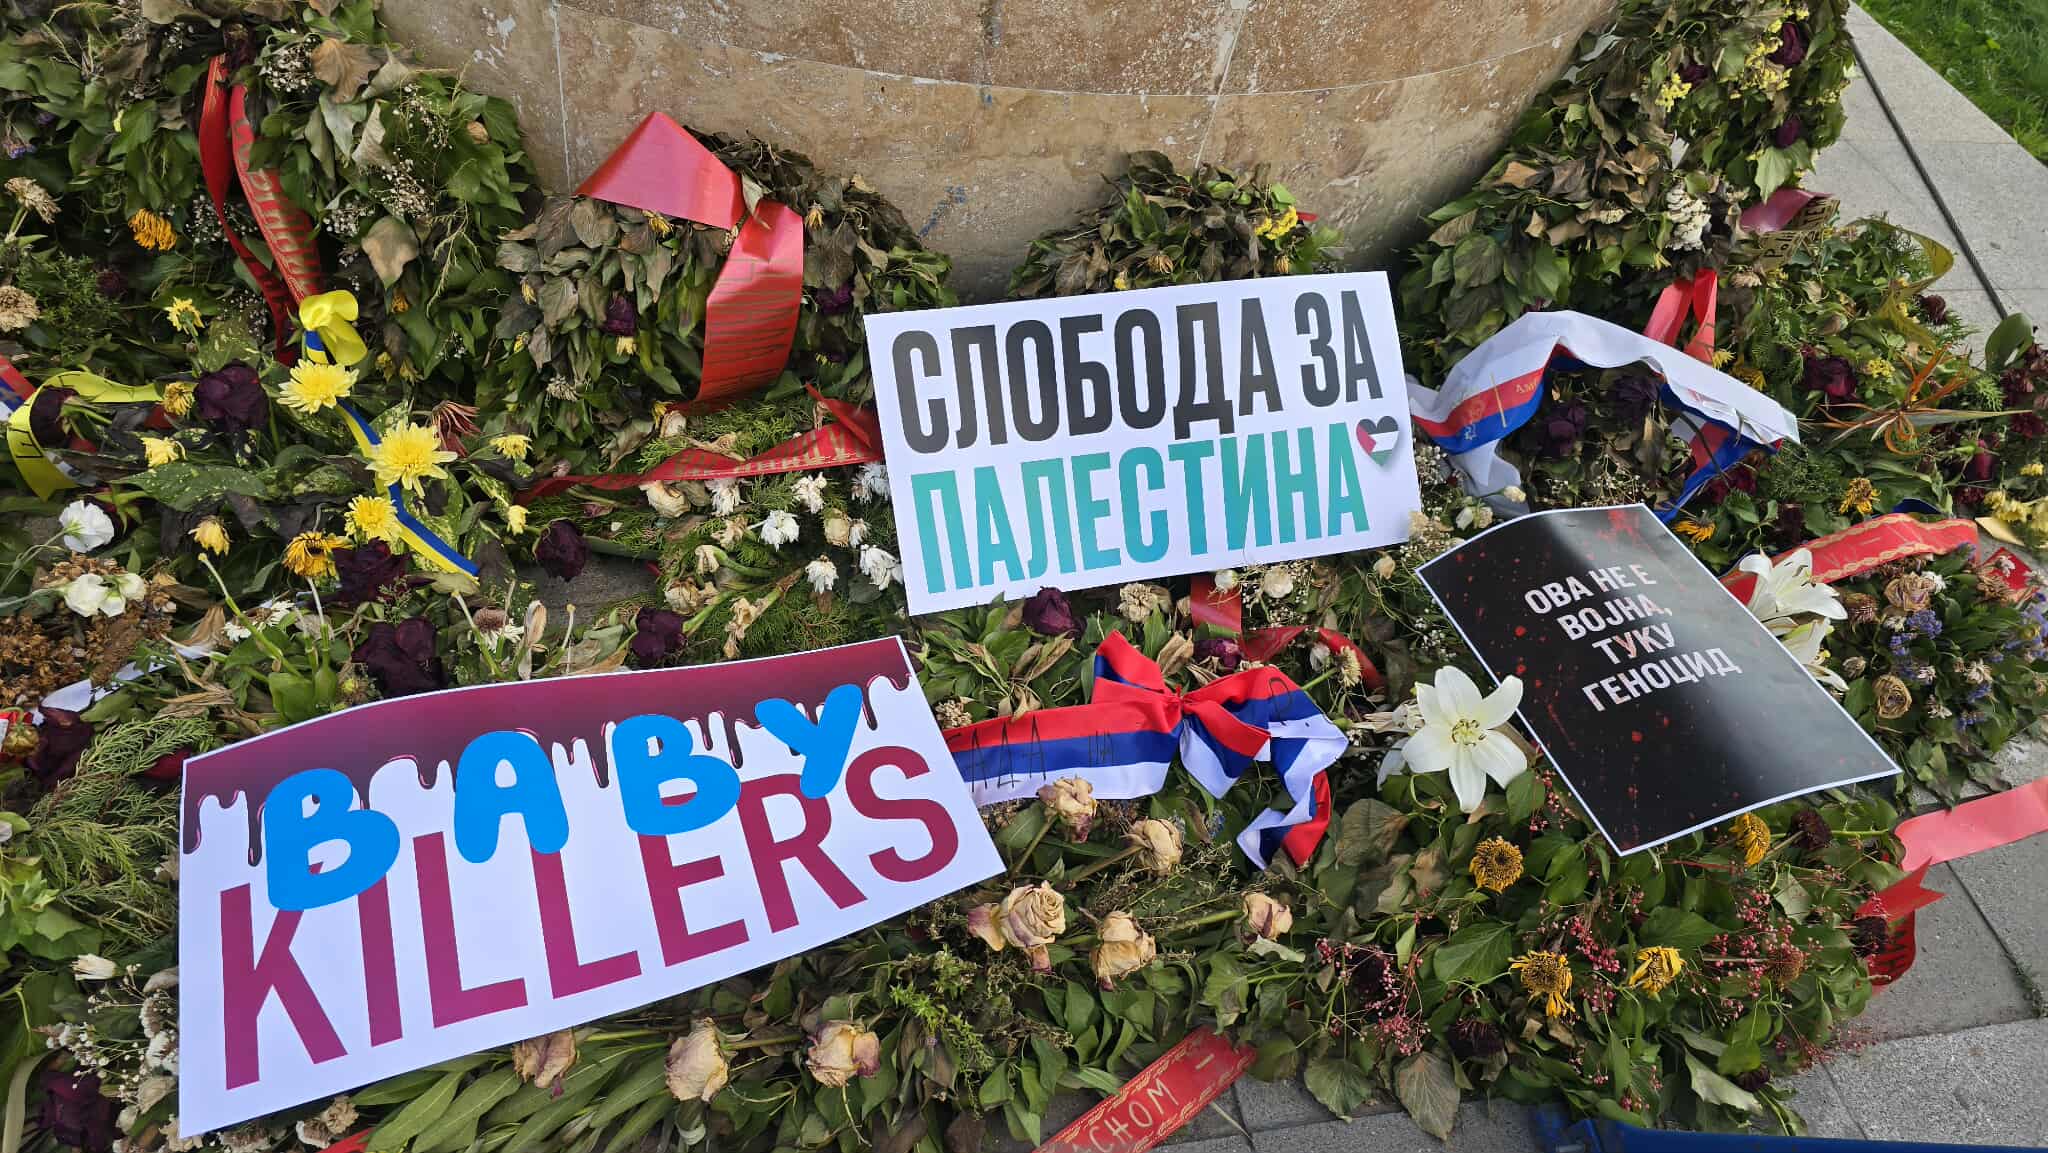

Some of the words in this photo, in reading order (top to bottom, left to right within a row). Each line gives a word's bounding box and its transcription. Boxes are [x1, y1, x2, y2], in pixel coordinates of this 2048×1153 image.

[892, 298, 1283, 454] СЛОБОДА
[1294, 290, 1383, 408] ЗА
[911, 422, 1368, 594] ПАЛЕСТИНА
[1524, 576, 1595, 614] ОВА
[1589, 565, 1637, 592] НЕ
[1630, 563, 1658, 585] Е
[1557, 593, 1674, 641] ВОЈНА,
[1592, 621, 1676, 665] ТУКУ
[1581, 647, 1744, 711] ГЕНОЦИД
[263, 684, 863, 912] BABY
[221, 746, 958, 1088] KILLERS
